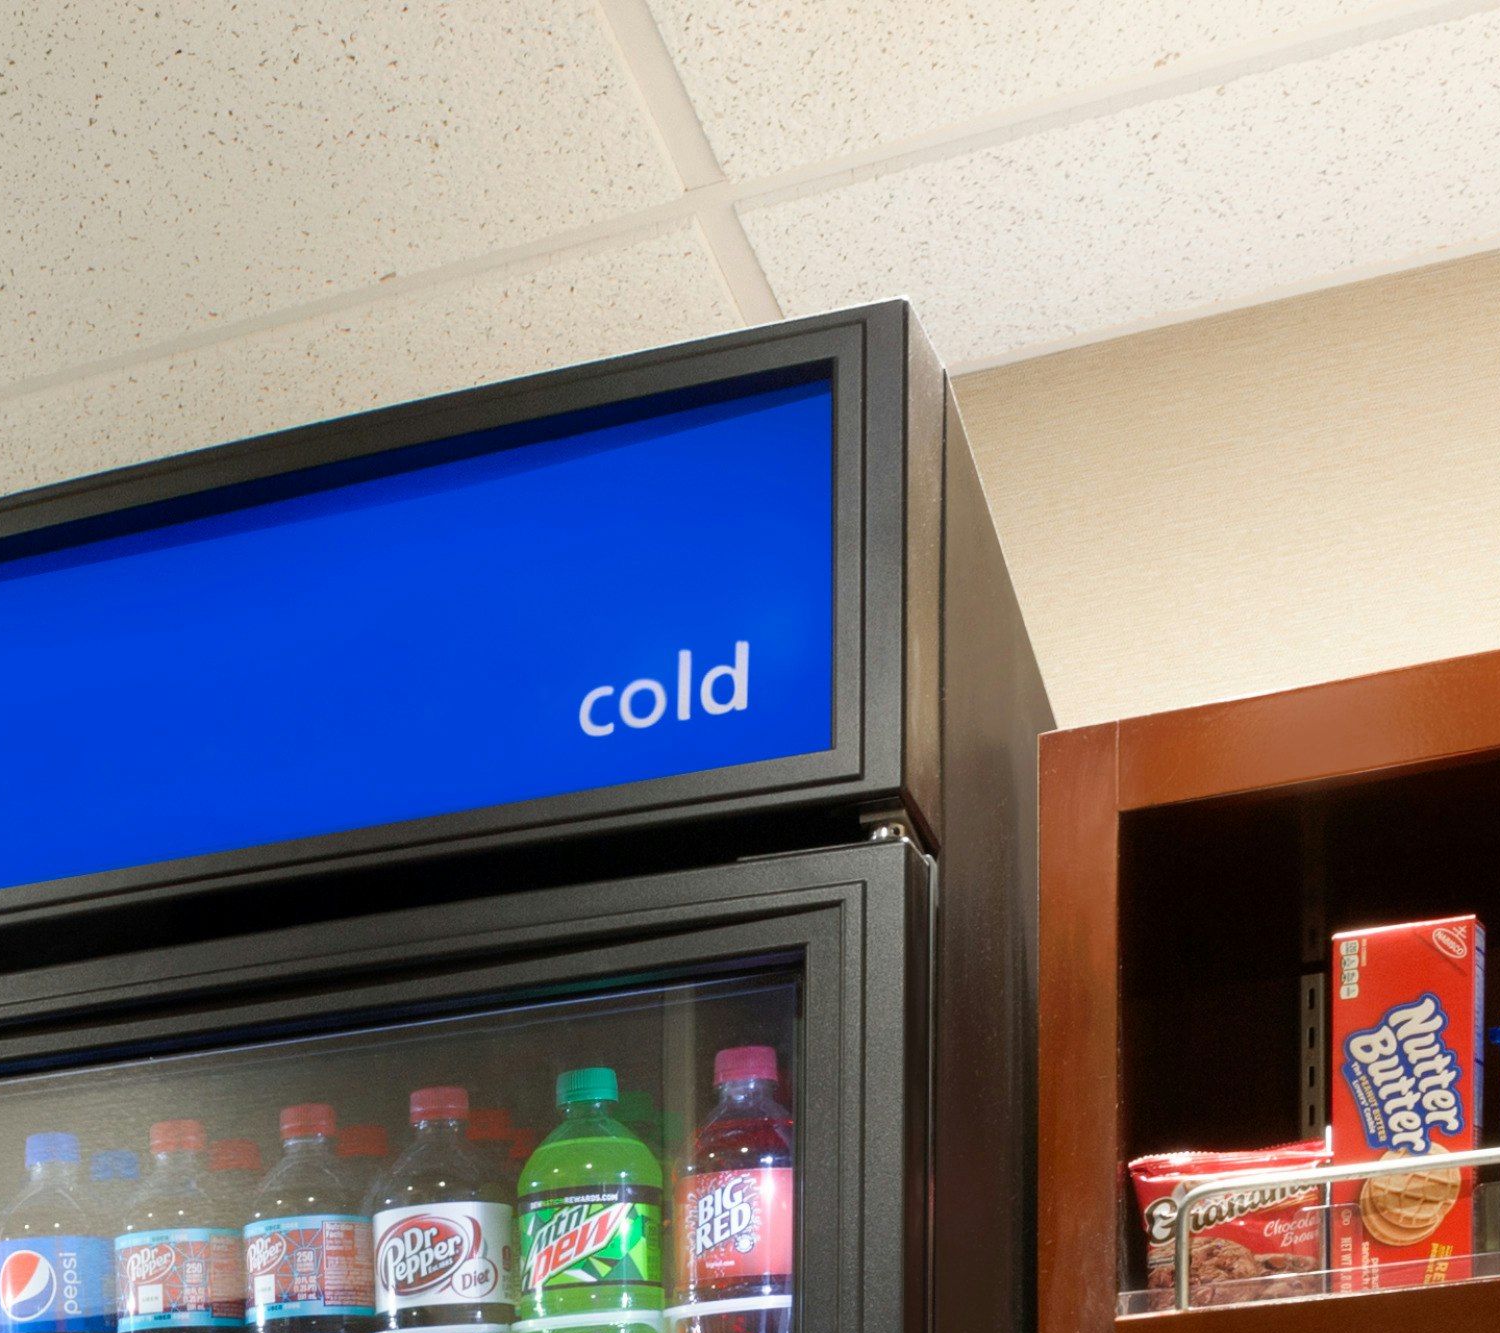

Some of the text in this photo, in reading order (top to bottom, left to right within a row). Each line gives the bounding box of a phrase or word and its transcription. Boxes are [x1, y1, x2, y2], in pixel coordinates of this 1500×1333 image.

[579, 640, 749, 736] cold
[1350, 1030, 1425, 1152] Butter
[1389, 998, 1460, 1132] Nutter
[1358, 1075, 1378, 1108] PEANUT
[1372, 1106, 1387, 1142] BUTTER
[698, 1202, 751, 1256] RED
[700, 1178, 744, 1221] BIG
[59, 1253, 82, 1315] pepsi
[387, 1226, 463, 1285] Dr Pepper
[461, 1268, 491, 1290] Diet
